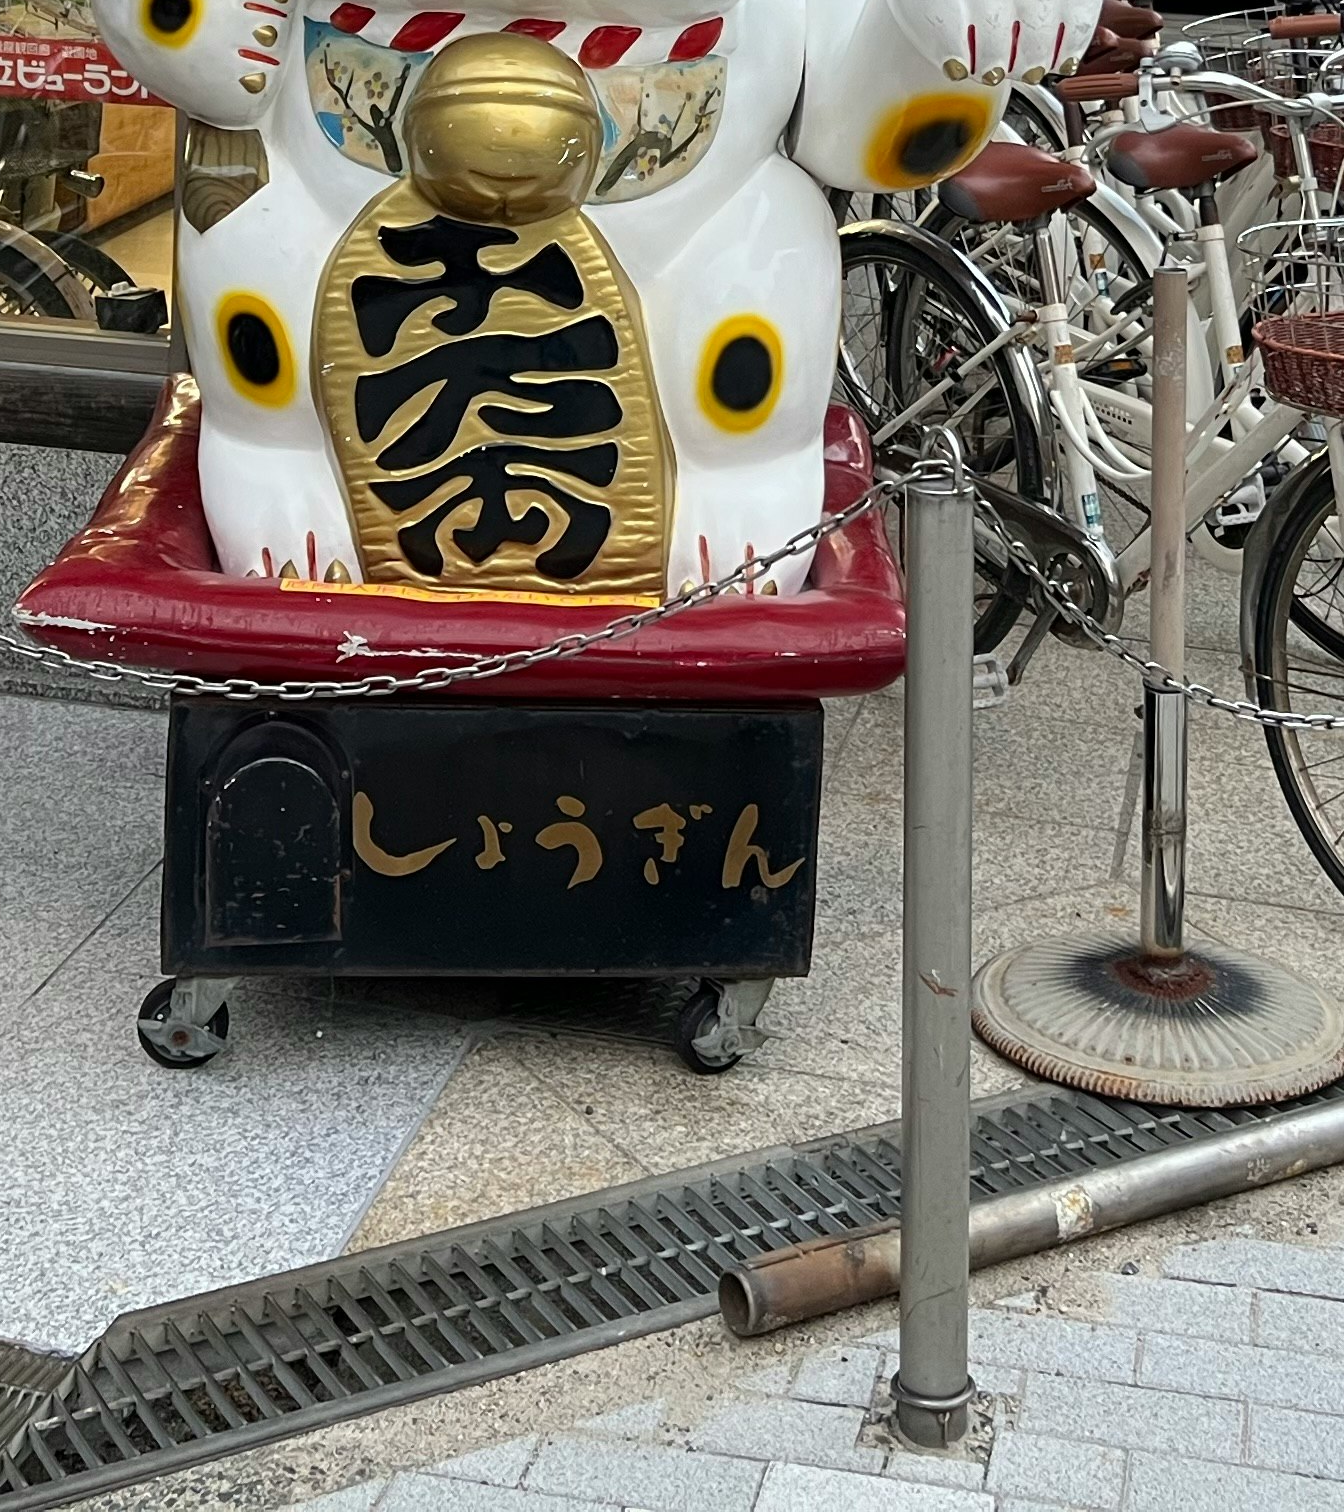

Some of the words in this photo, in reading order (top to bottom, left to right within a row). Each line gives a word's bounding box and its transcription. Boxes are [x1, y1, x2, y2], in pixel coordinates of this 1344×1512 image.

[353, 790, 806, 889] しょうぎん
